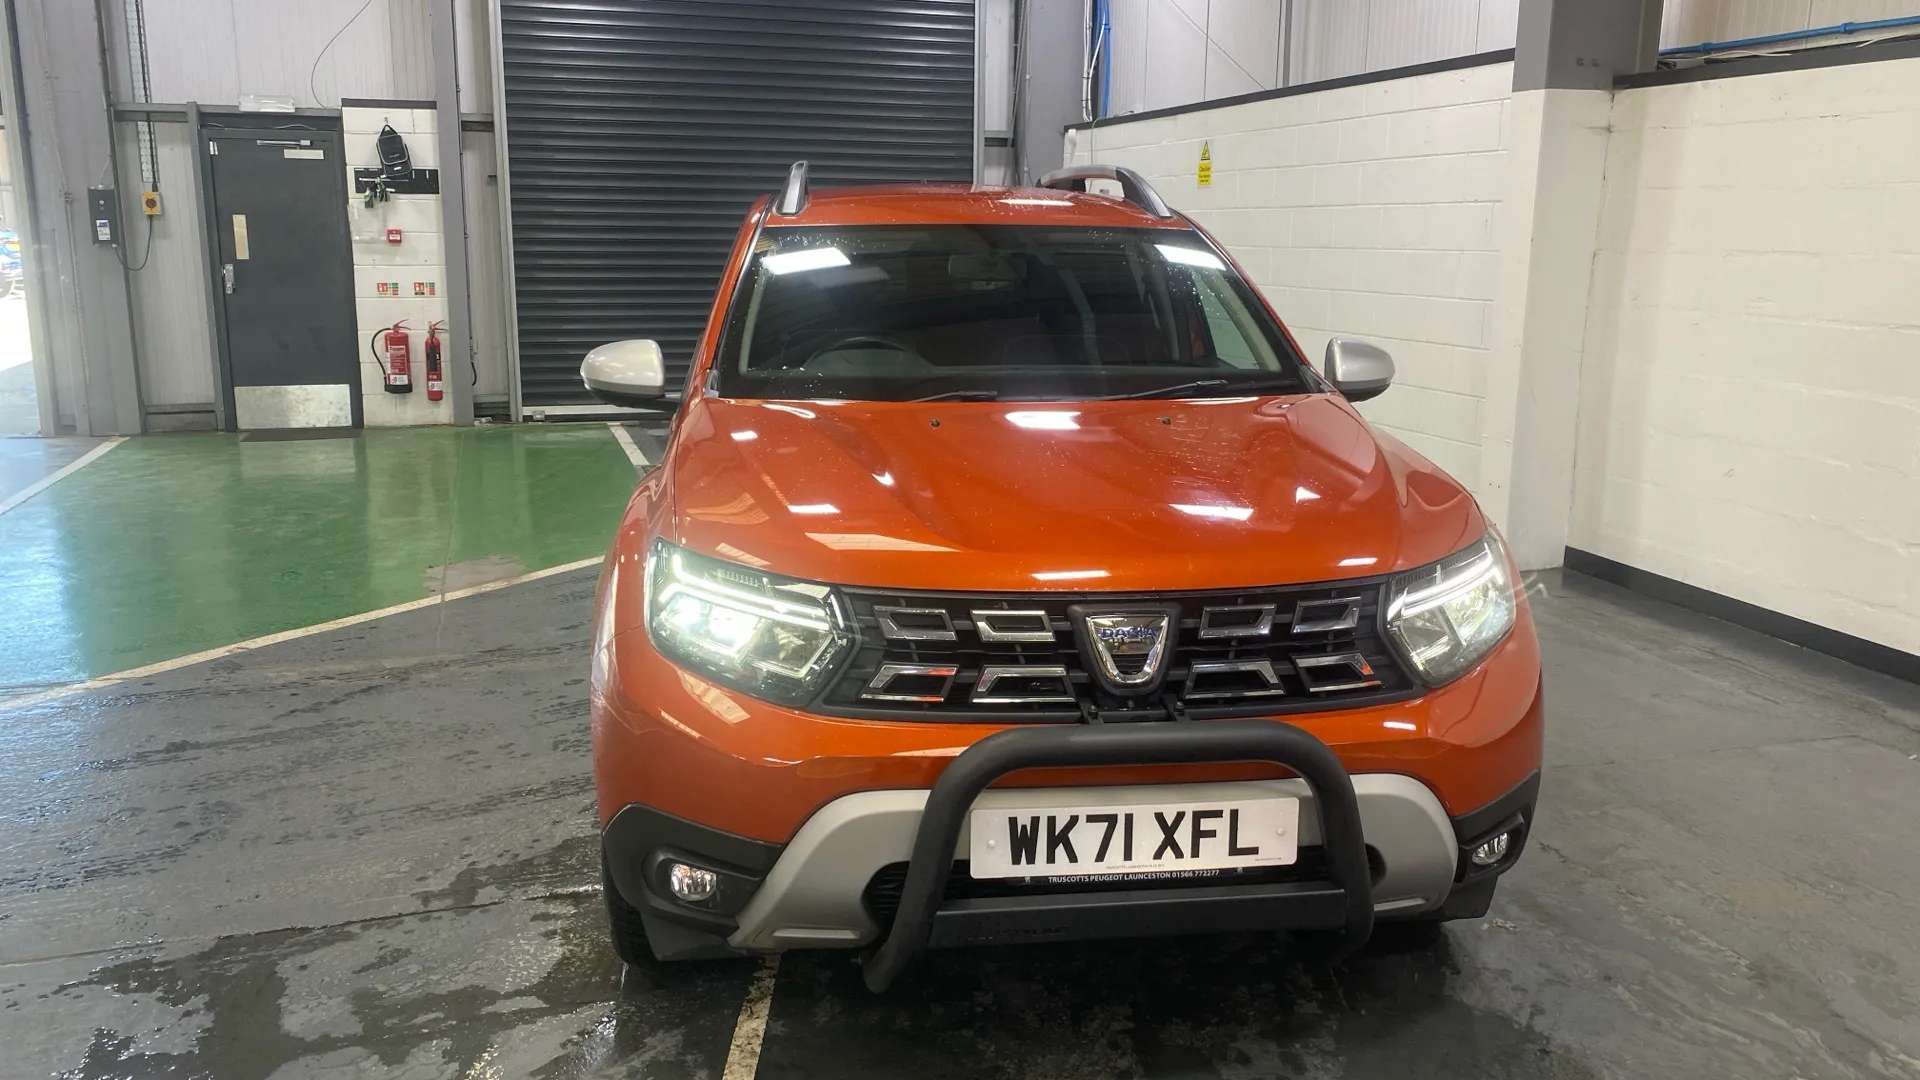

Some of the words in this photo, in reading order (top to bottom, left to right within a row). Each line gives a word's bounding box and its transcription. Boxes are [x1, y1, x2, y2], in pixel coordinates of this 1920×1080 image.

[1099, 627, 1157, 640] DACIA
[1008, 813, 1134, 865] WK71
[1153, 808, 1259, 860] XFL
[1048, 875, 1089, 883] TRUSCOTTS
[1090, 873, 1123, 882] PEUGEOT
[1124, 871, 1171, 880] LAUNCESTON
